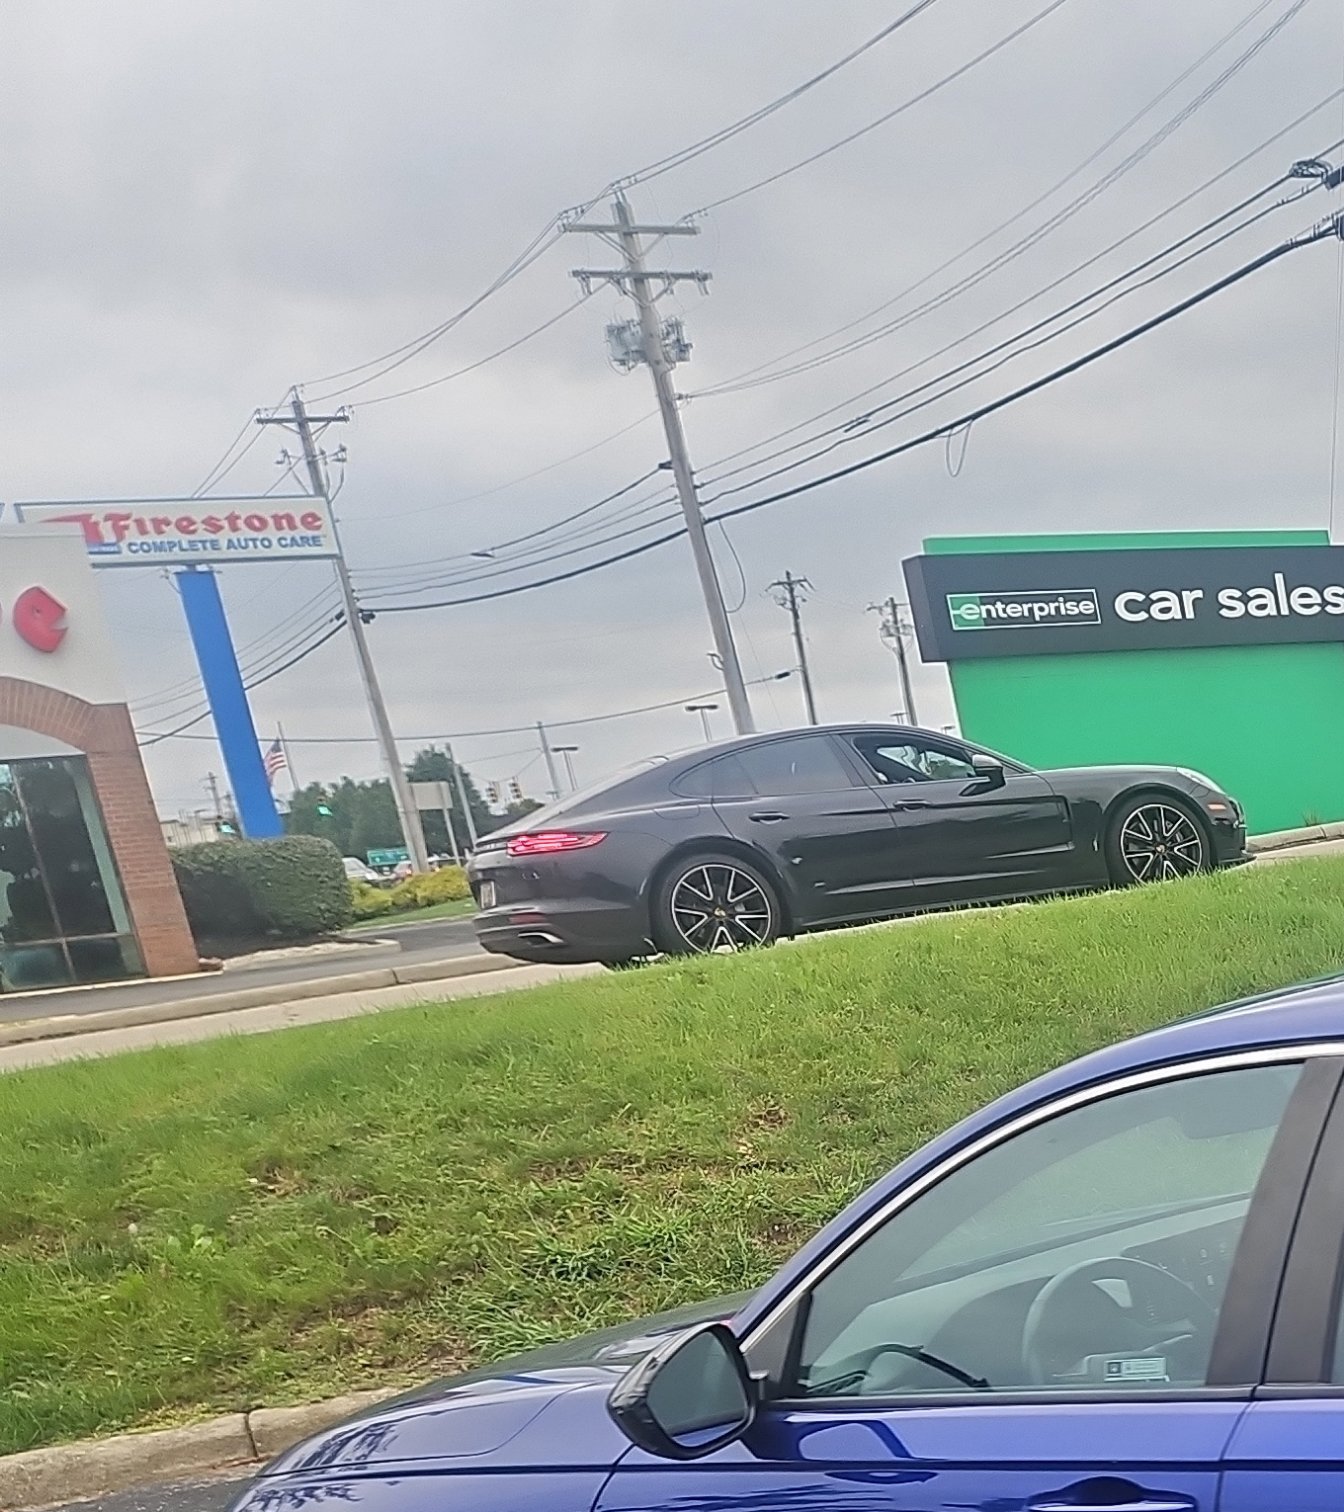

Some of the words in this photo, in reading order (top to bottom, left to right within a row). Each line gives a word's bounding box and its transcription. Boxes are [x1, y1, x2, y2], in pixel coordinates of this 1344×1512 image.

[103, 510, 324, 543] Firestone
[127, 539, 221, 554] COMPLETE
[226, 536, 273, 551] AUTO
[278, 534, 323, 549] CARE
[953, 596, 1095, 622] enterprise
[1114, 589, 1204, 622] car
